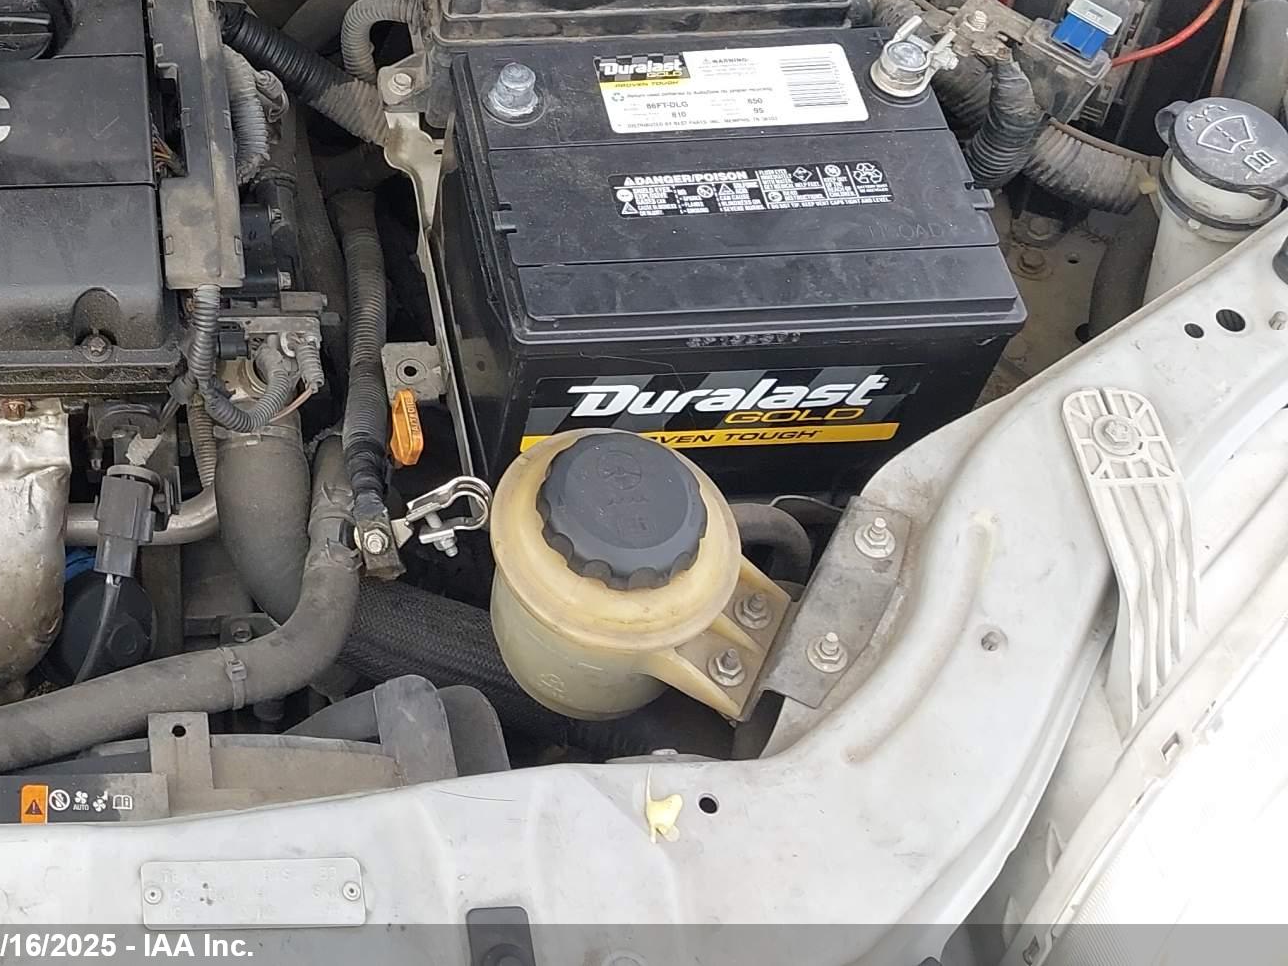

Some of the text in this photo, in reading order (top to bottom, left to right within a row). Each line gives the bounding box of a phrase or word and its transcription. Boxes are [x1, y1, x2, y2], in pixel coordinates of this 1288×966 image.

[599, 59, 683, 75] Duralast
[633, 171, 748, 185] DANGER/POISON
[567, 374, 888, 416] Duralast
[723, 408, 865, 424] GOLD
[651, 430, 818, 444] VEN TOUGH
